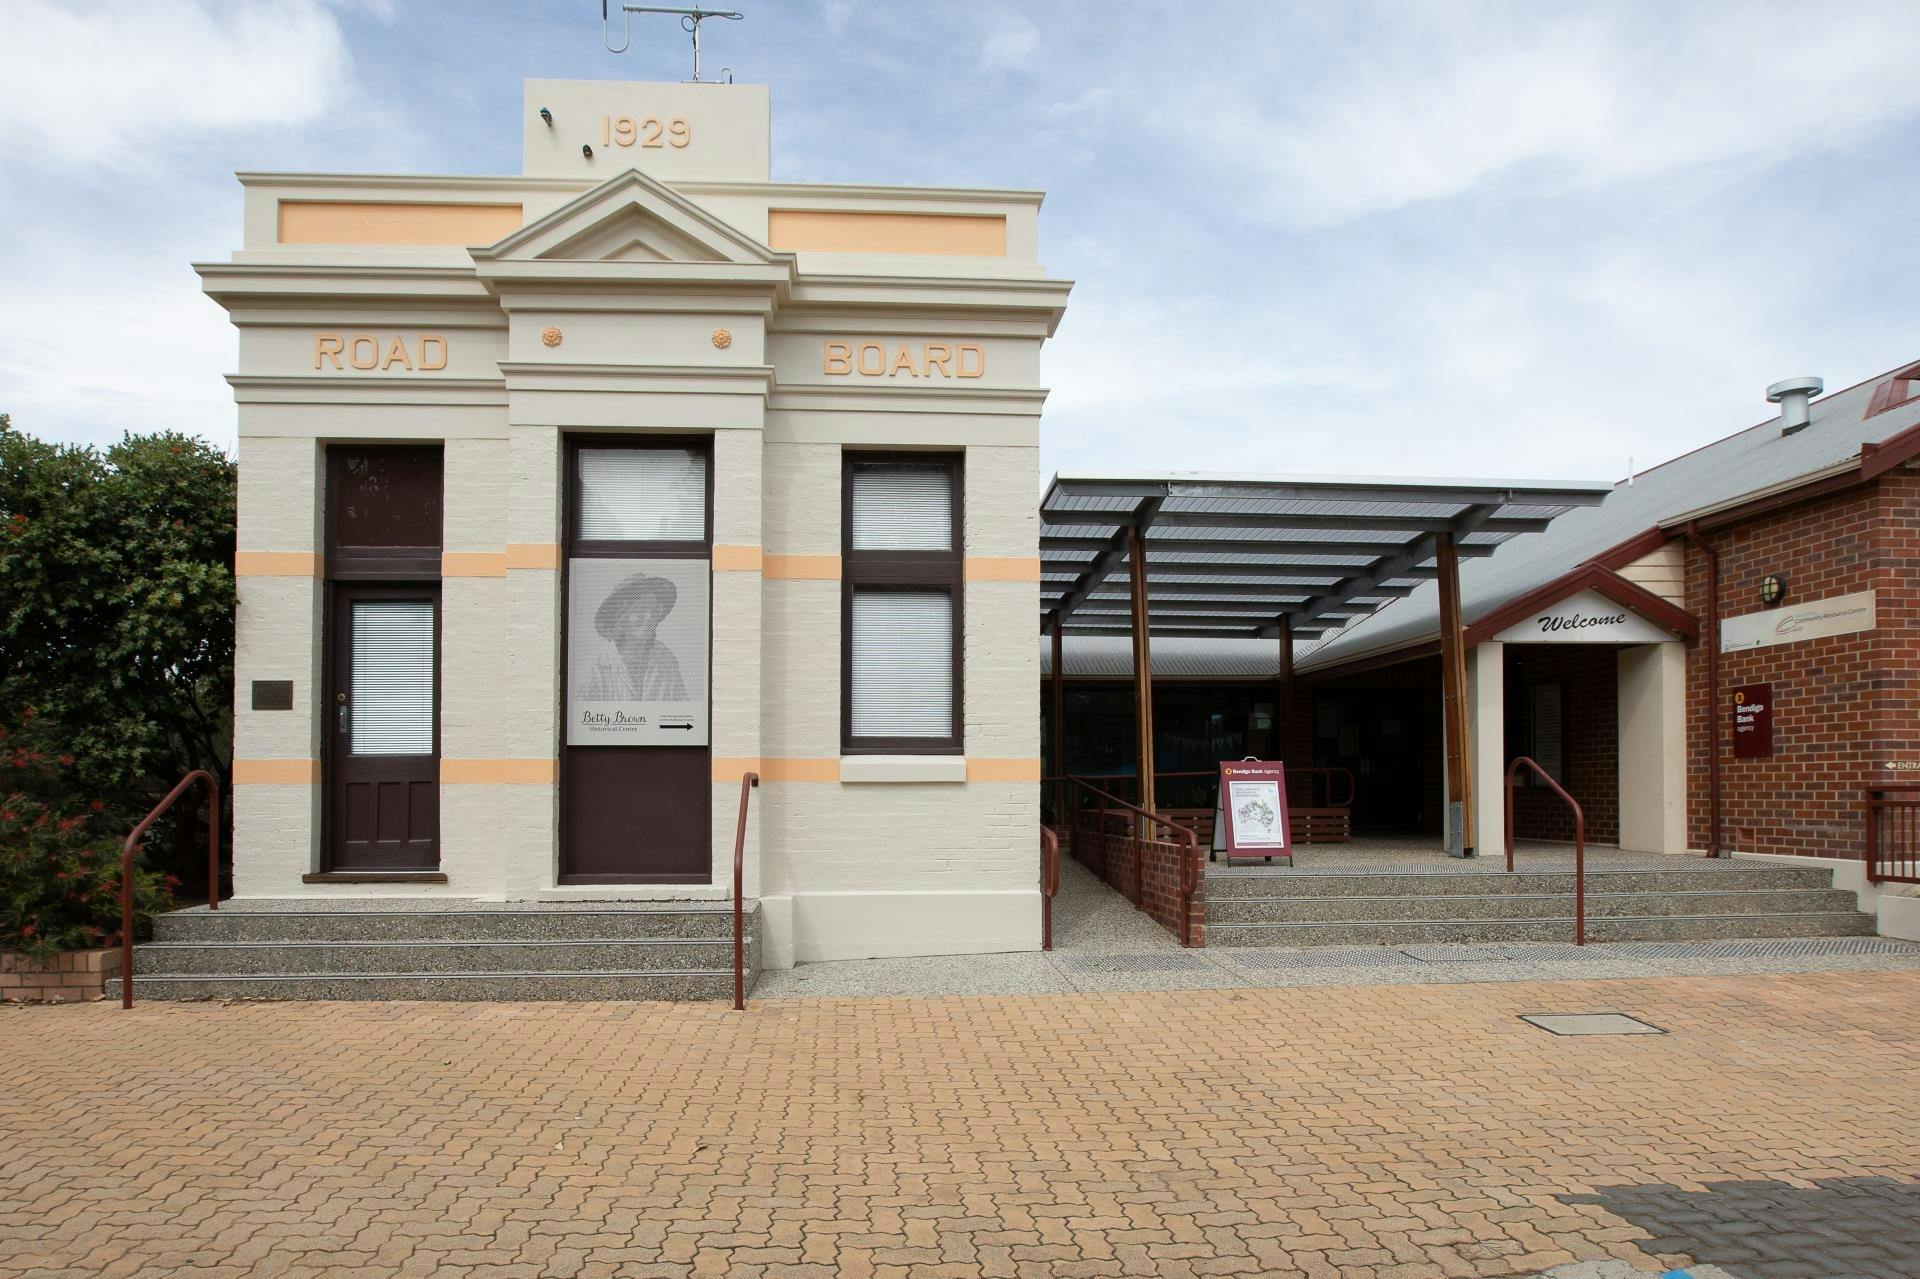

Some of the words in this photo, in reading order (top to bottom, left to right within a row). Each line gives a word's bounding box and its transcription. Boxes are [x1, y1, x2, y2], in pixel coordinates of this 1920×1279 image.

[603, 115, 692, 148] 1929
[314, 334, 448, 371] ROAD
[823, 340, 986, 378] BOARD
[1538, 613, 1626, 632] Welcome
[1737, 704, 1764, 713] Bendigo
[581, 711, 611, 726] Betty
[614, 711, 647, 723] Brown
[1737, 715, 1754, 723] Bank
[1737, 725, 1755, 733] agency
